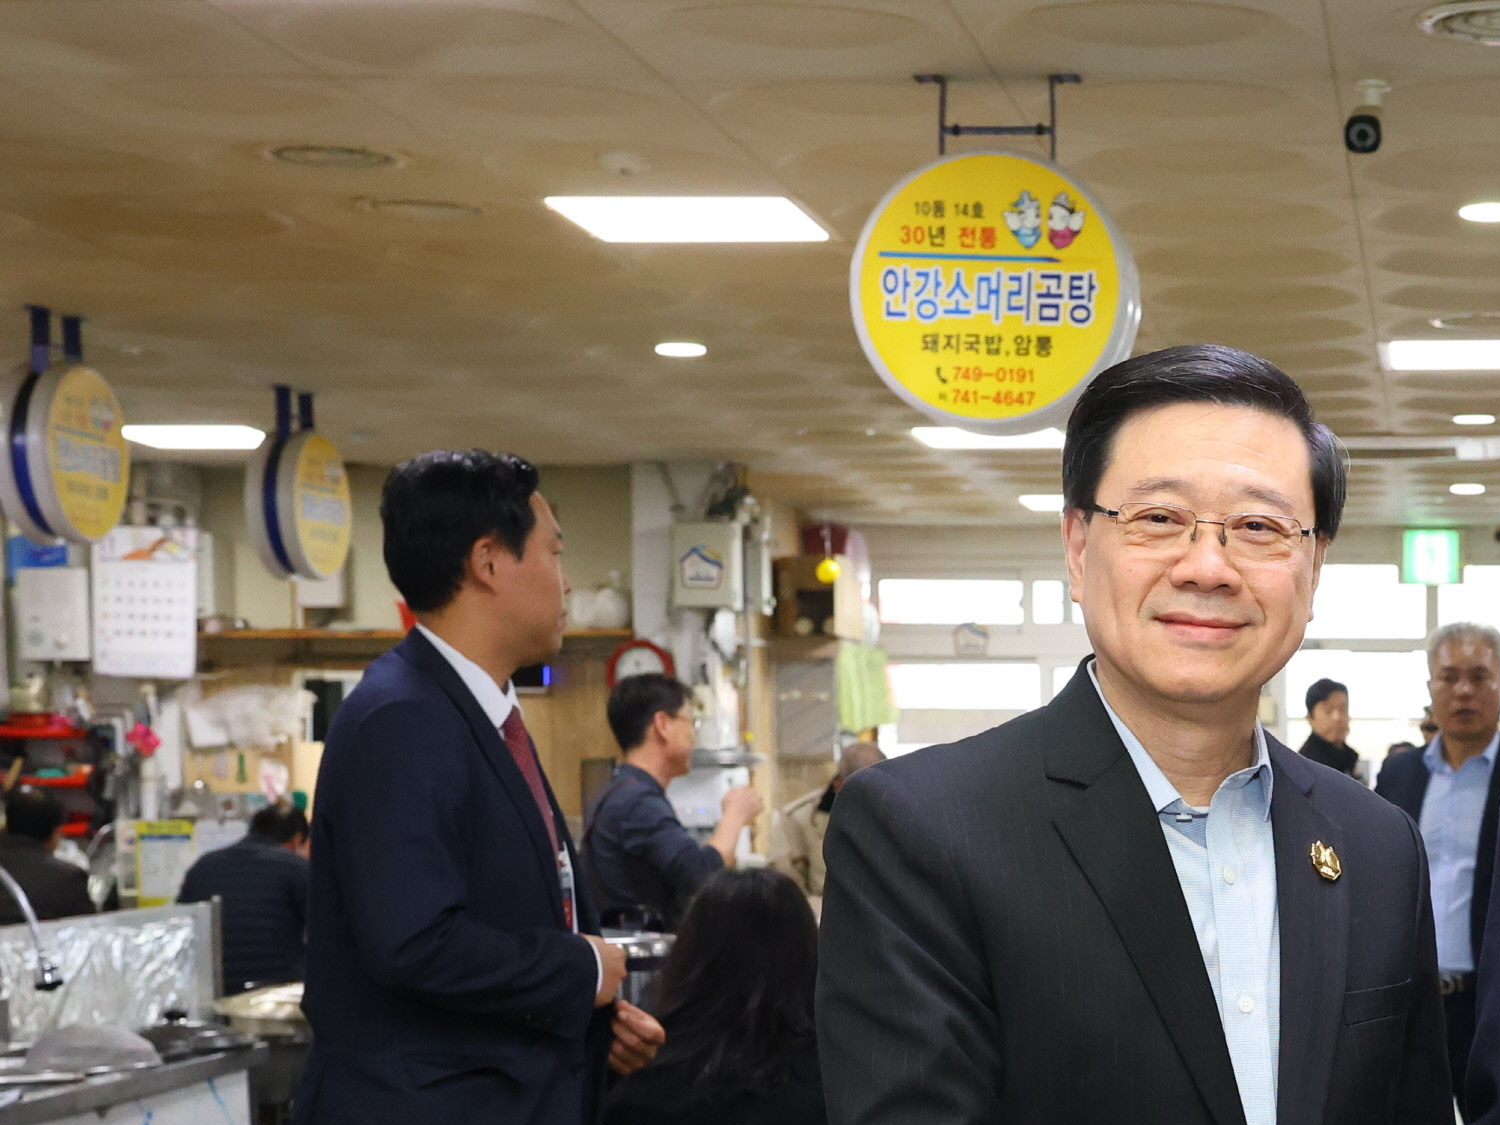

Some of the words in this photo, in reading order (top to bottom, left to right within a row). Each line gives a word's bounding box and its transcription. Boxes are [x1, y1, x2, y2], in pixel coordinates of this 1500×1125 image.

[915, 200, 945, 218] 10동
[954, 201, 985, 218] 14호
[901, 224, 945, 247] 30년
[958, 226, 997, 249] 전통
[882, 267, 1096, 324] 안강소머리곰탕
[953, 366, 1035, 383] 749-0191
[952, 388, 1036, 406] 741-4647
